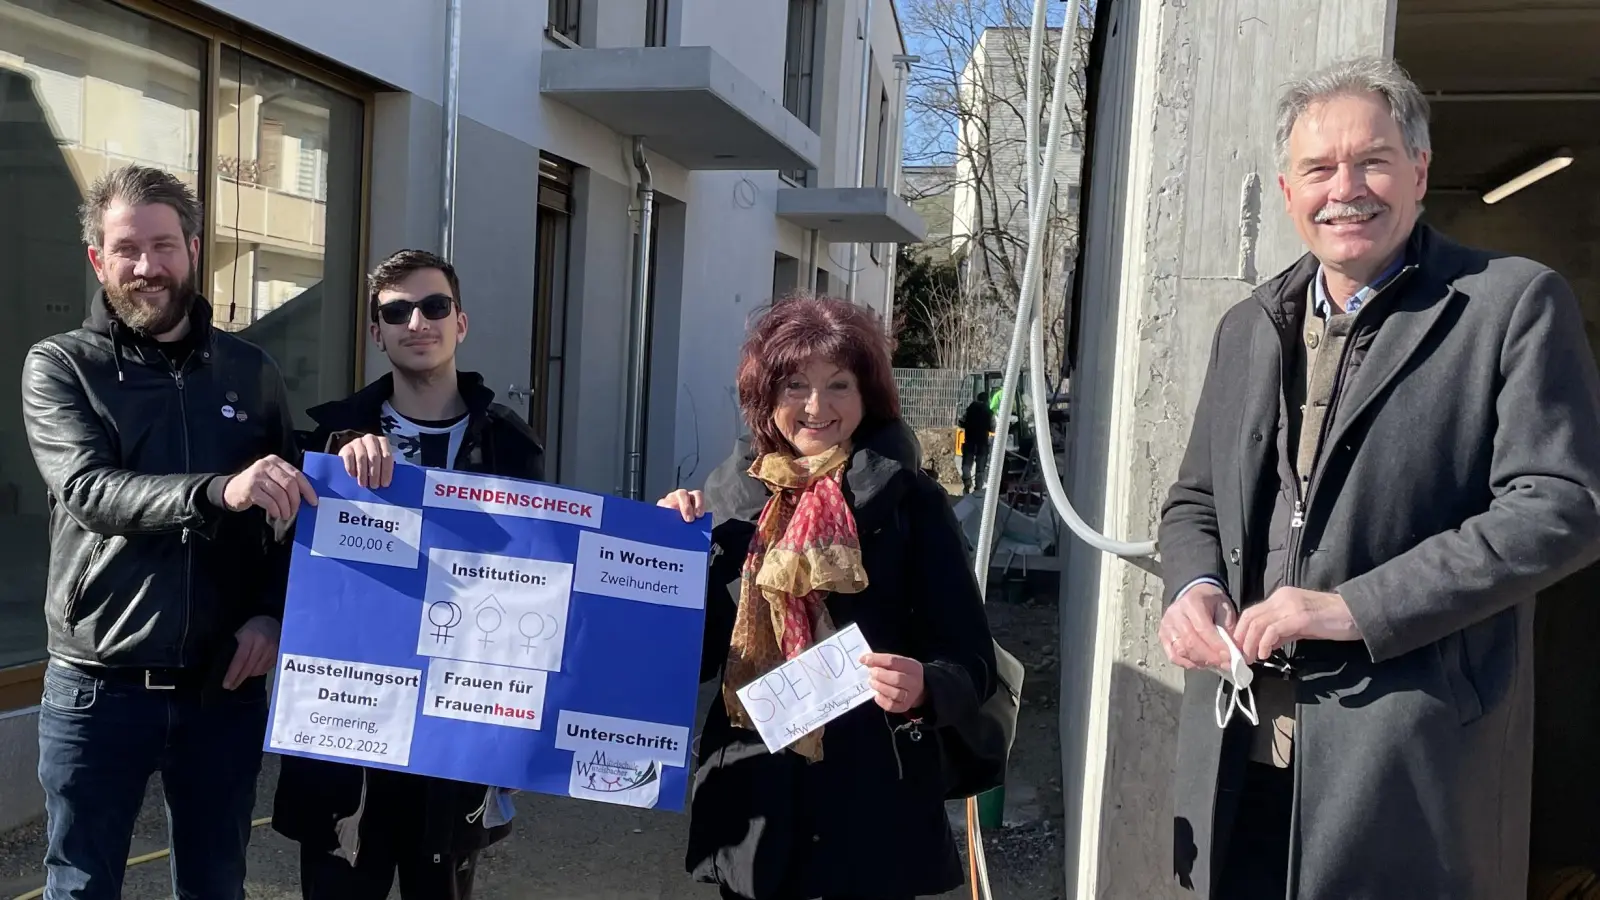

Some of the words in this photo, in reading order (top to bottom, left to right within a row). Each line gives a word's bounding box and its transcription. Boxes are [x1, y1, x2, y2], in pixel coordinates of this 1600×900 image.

[434, 484, 593, 518] SPENDENSCHECK
[338, 512, 400, 532] Betrag:
[339, 535, 382, 551] 200,00
[386, 539, 394, 552] €
[599, 547, 615, 561] in
[620, 548, 684, 573] Worten:
[452, 563, 547, 586] Institution:
[600, 571, 679, 595] Zweihundert
[284, 659, 418, 688] Ausstellungsort
[444, 672, 504, 691] Frauen
[509, 679, 533, 694] für
[747, 627, 863, 722] SPENDE
[318, 689, 378, 707] Datum:
[434, 695, 535, 720] Frauenhaus
[310, 711, 379, 734] Germering,
[294, 731, 314, 745] der
[318, 733, 388, 755] 25.02.2022
[567, 724, 678, 751] Unterschrift:
